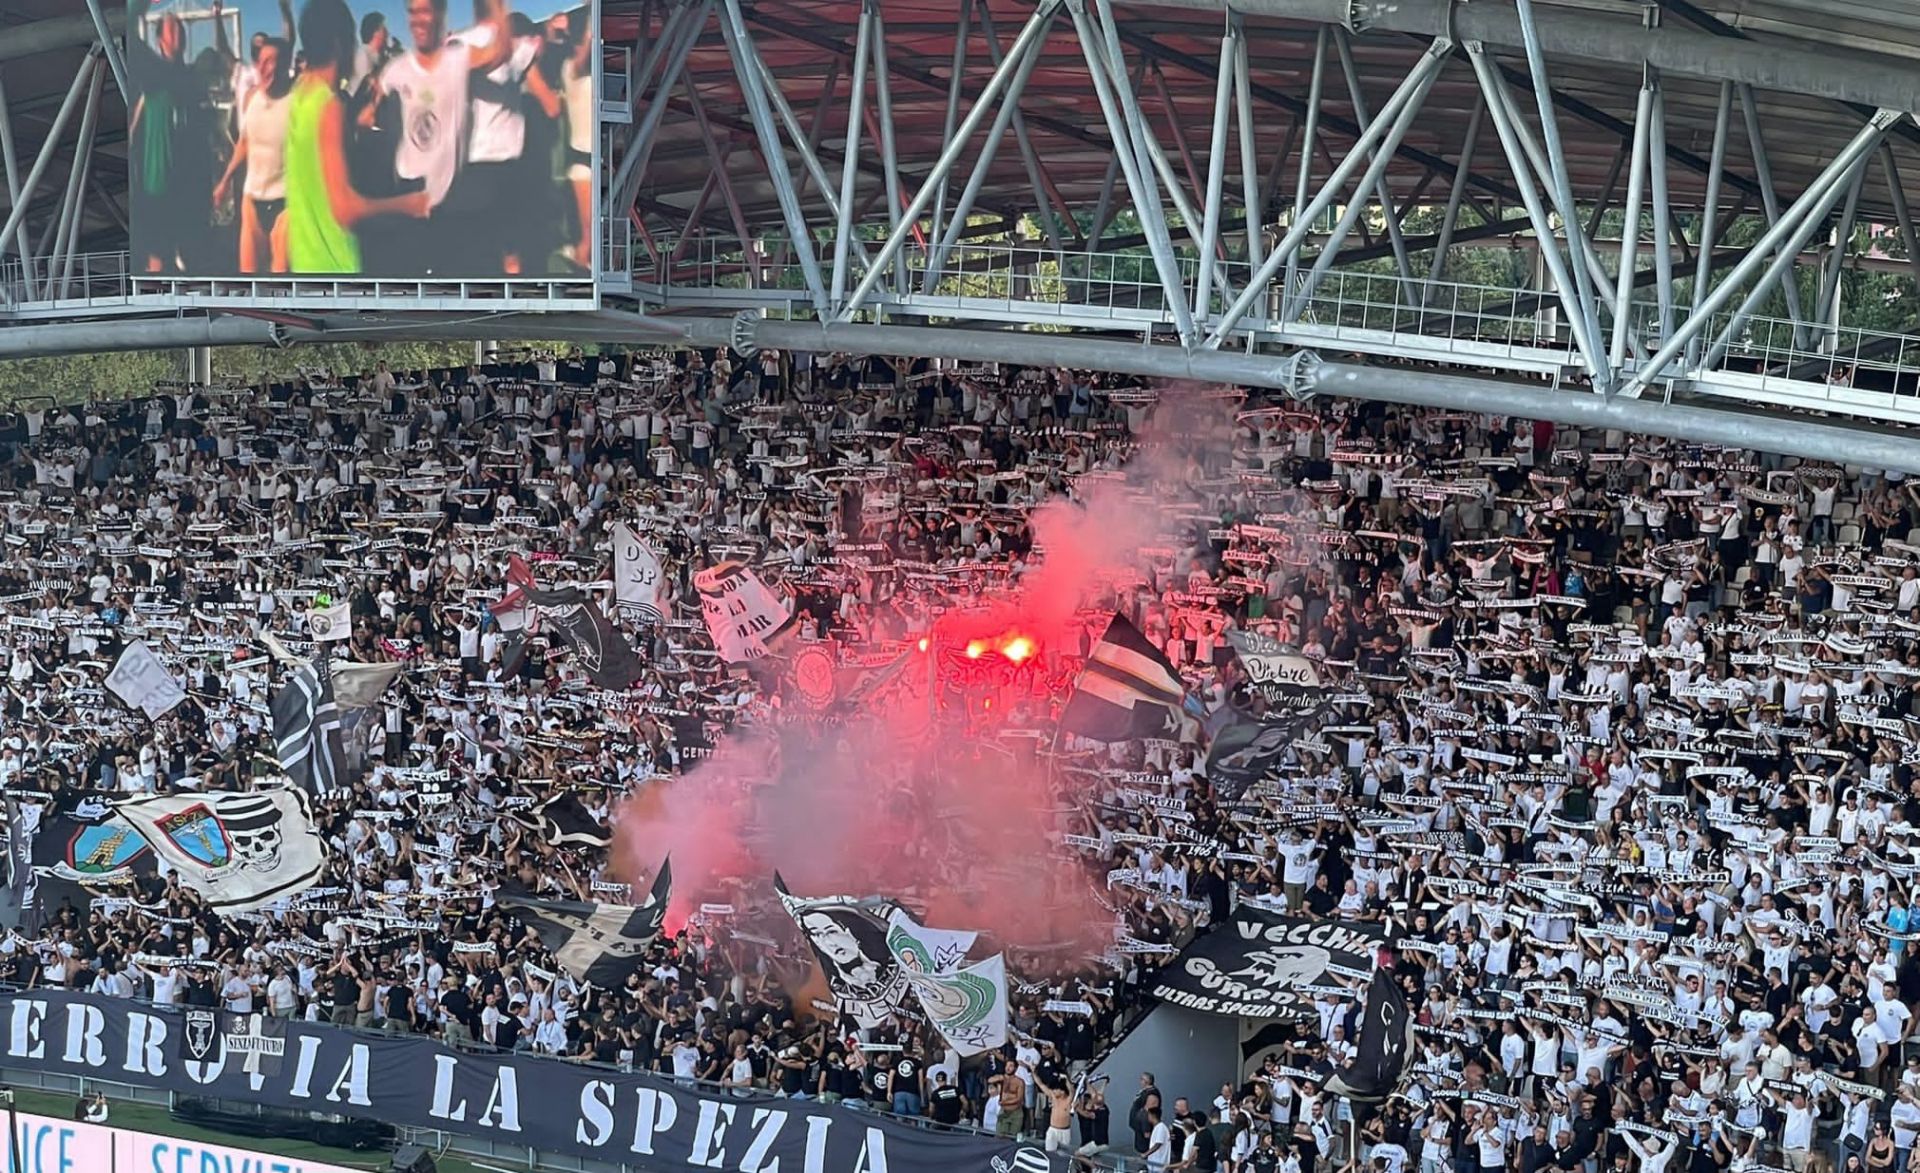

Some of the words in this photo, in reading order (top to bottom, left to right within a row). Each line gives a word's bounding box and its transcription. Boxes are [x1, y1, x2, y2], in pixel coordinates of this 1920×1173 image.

[1216, 1000, 1272, 1018] SPEZIA
[429, 1053, 522, 1133] LA
[575, 1080, 887, 1173] SPEZIA
